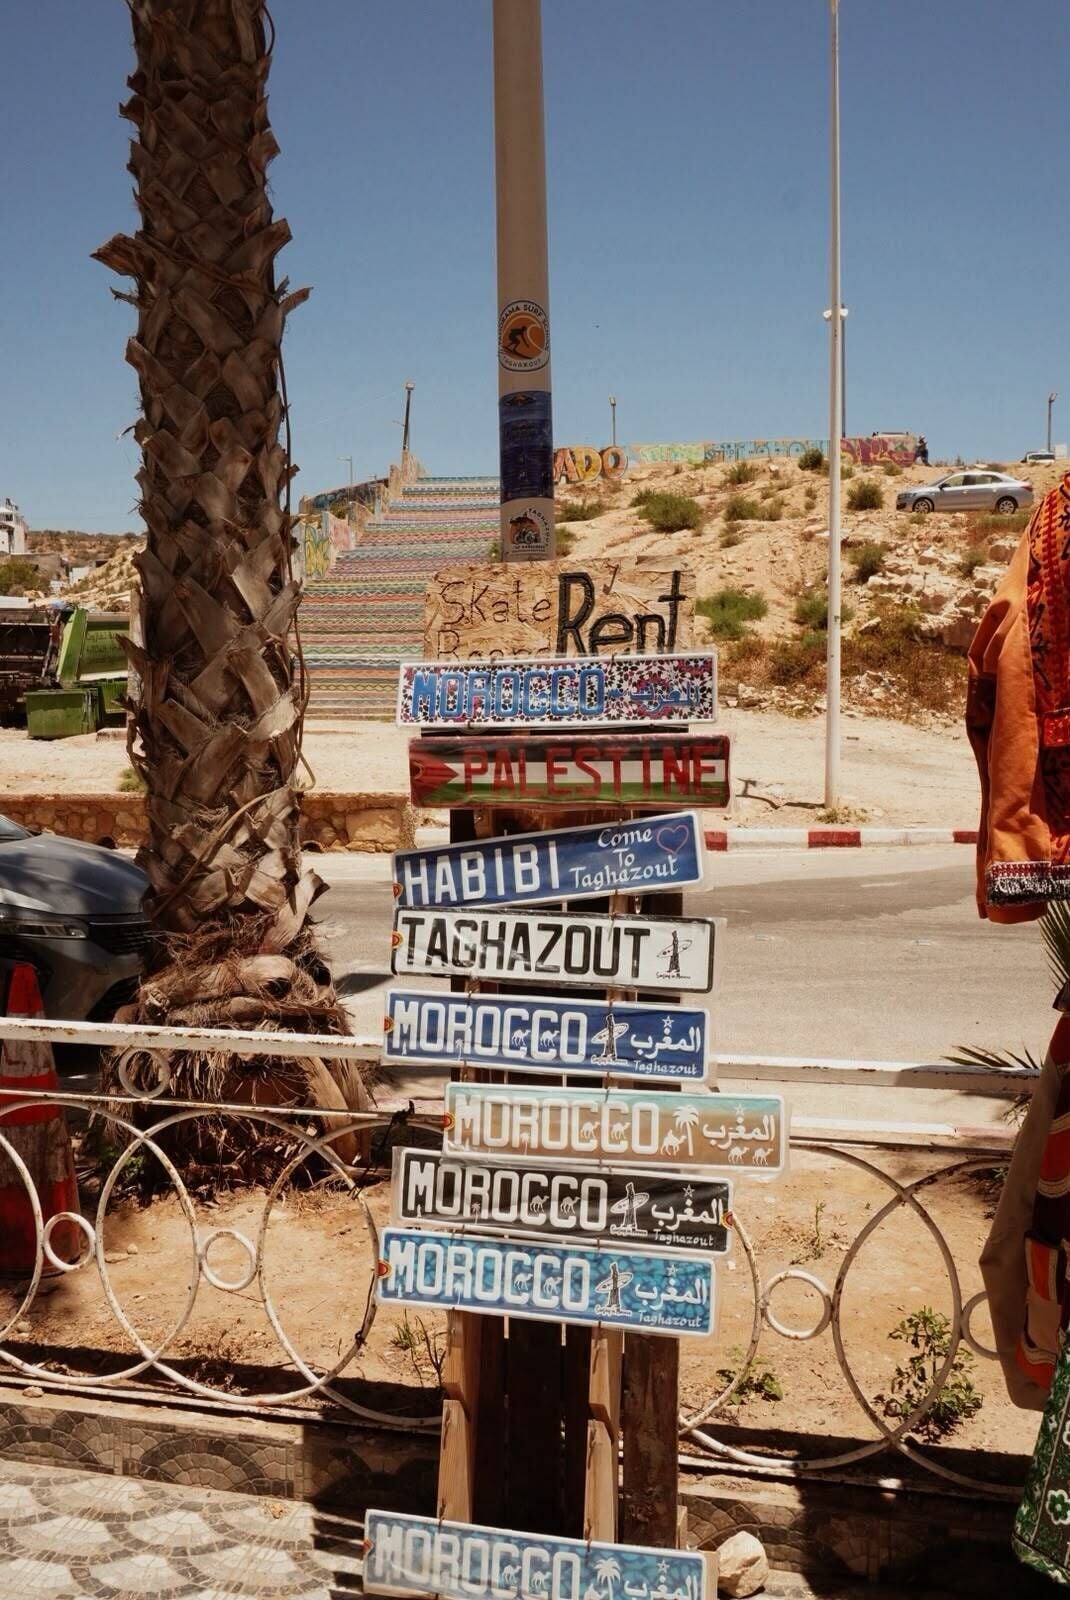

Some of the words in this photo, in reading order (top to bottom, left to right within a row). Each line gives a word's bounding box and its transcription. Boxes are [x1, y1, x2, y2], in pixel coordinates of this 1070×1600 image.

[440, 579, 552, 625] Skate
[556, 570, 687, 658] Rent
[410, 668, 605, 719] MOROCCO
[464, 745, 721, 797] PALESTINE
[598, 828, 653, 848] Come
[613, 848, 635, 867] To
[404, 840, 560, 907] HABIBI
[568, 854, 679, 891] Taghazout
[401, 916, 651, 978] TAGHAZOUT
[393, 1000, 588, 1063] MOROCCO
[630, 1026, 701, 1060] المغرب
[633, 1060, 697, 1076] Taghazout
[454, 1094, 660, 1155] MOROCCO
[702, 1114, 775, 1149] المغرب
[407, 1161, 608, 1232] MOROCCO
[651, 1198, 723, 1231] المغرب
[653, 1228, 714, 1246] Taghazout
[387, 1240, 590, 1312] MOROCCO
[635, 1278, 707, 1310] المغرب
[638, 1309, 702, 1327] Taghazout
[374, 1523, 582, 1600] MOROCCO
